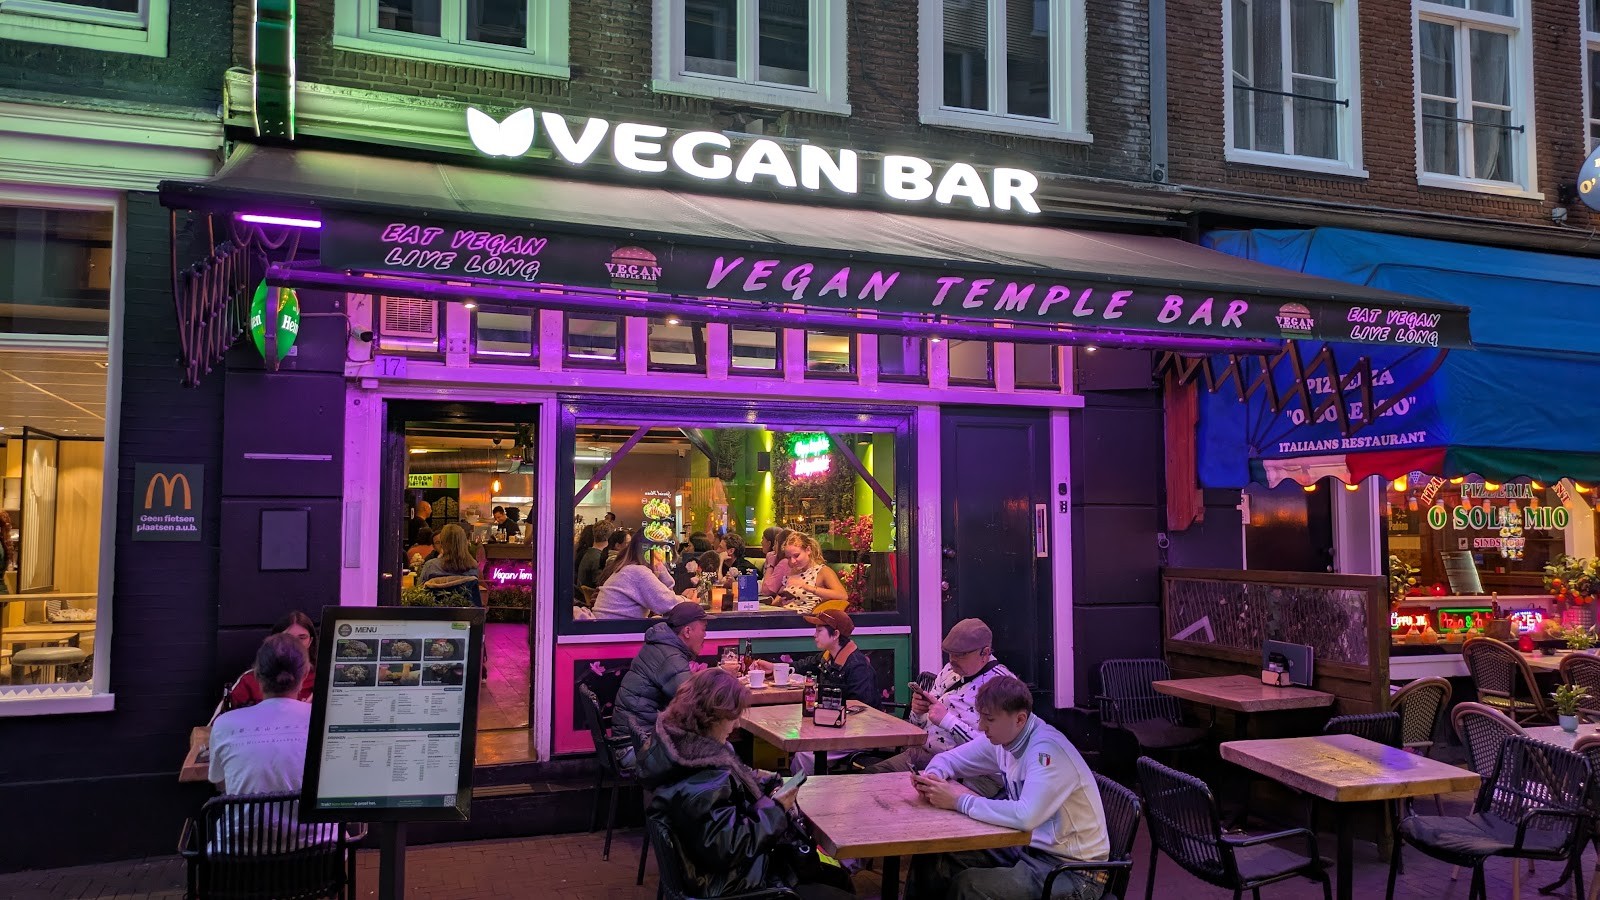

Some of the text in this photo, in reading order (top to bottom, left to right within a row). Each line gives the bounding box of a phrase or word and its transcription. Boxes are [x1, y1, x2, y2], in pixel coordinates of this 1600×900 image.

[541, 111, 1042, 214] VEGAN BAR
[381, 223, 547, 256] EAT VEGAN
[384, 247, 541, 281] LIVE LONG
[604, 262, 662, 277] VEGAN
[610, 272, 640, 280] TEMPLE
[706, 256, 1249, 329] VEGAN TEMPLE BAR
[1275, 316, 1314, 328] VEGAN
[1347, 306, 1441, 328] EAT VEGAN
[1349, 324, 1439, 347] LIVE LONG
[381, 357, 401, 376] 17
[1279, 431, 1427, 453] ITALIAANS RESTAURANT
[136, 523, 175, 532] plaatsen
[140, 514, 195, 523] Geen fietsen
[1427, 505, 1447, 530] O
[1524, 505, 1569, 530] MIO
[1474, 538, 1501, 548] SINDS
[493, 568, 532, 583] Vegan Tem
